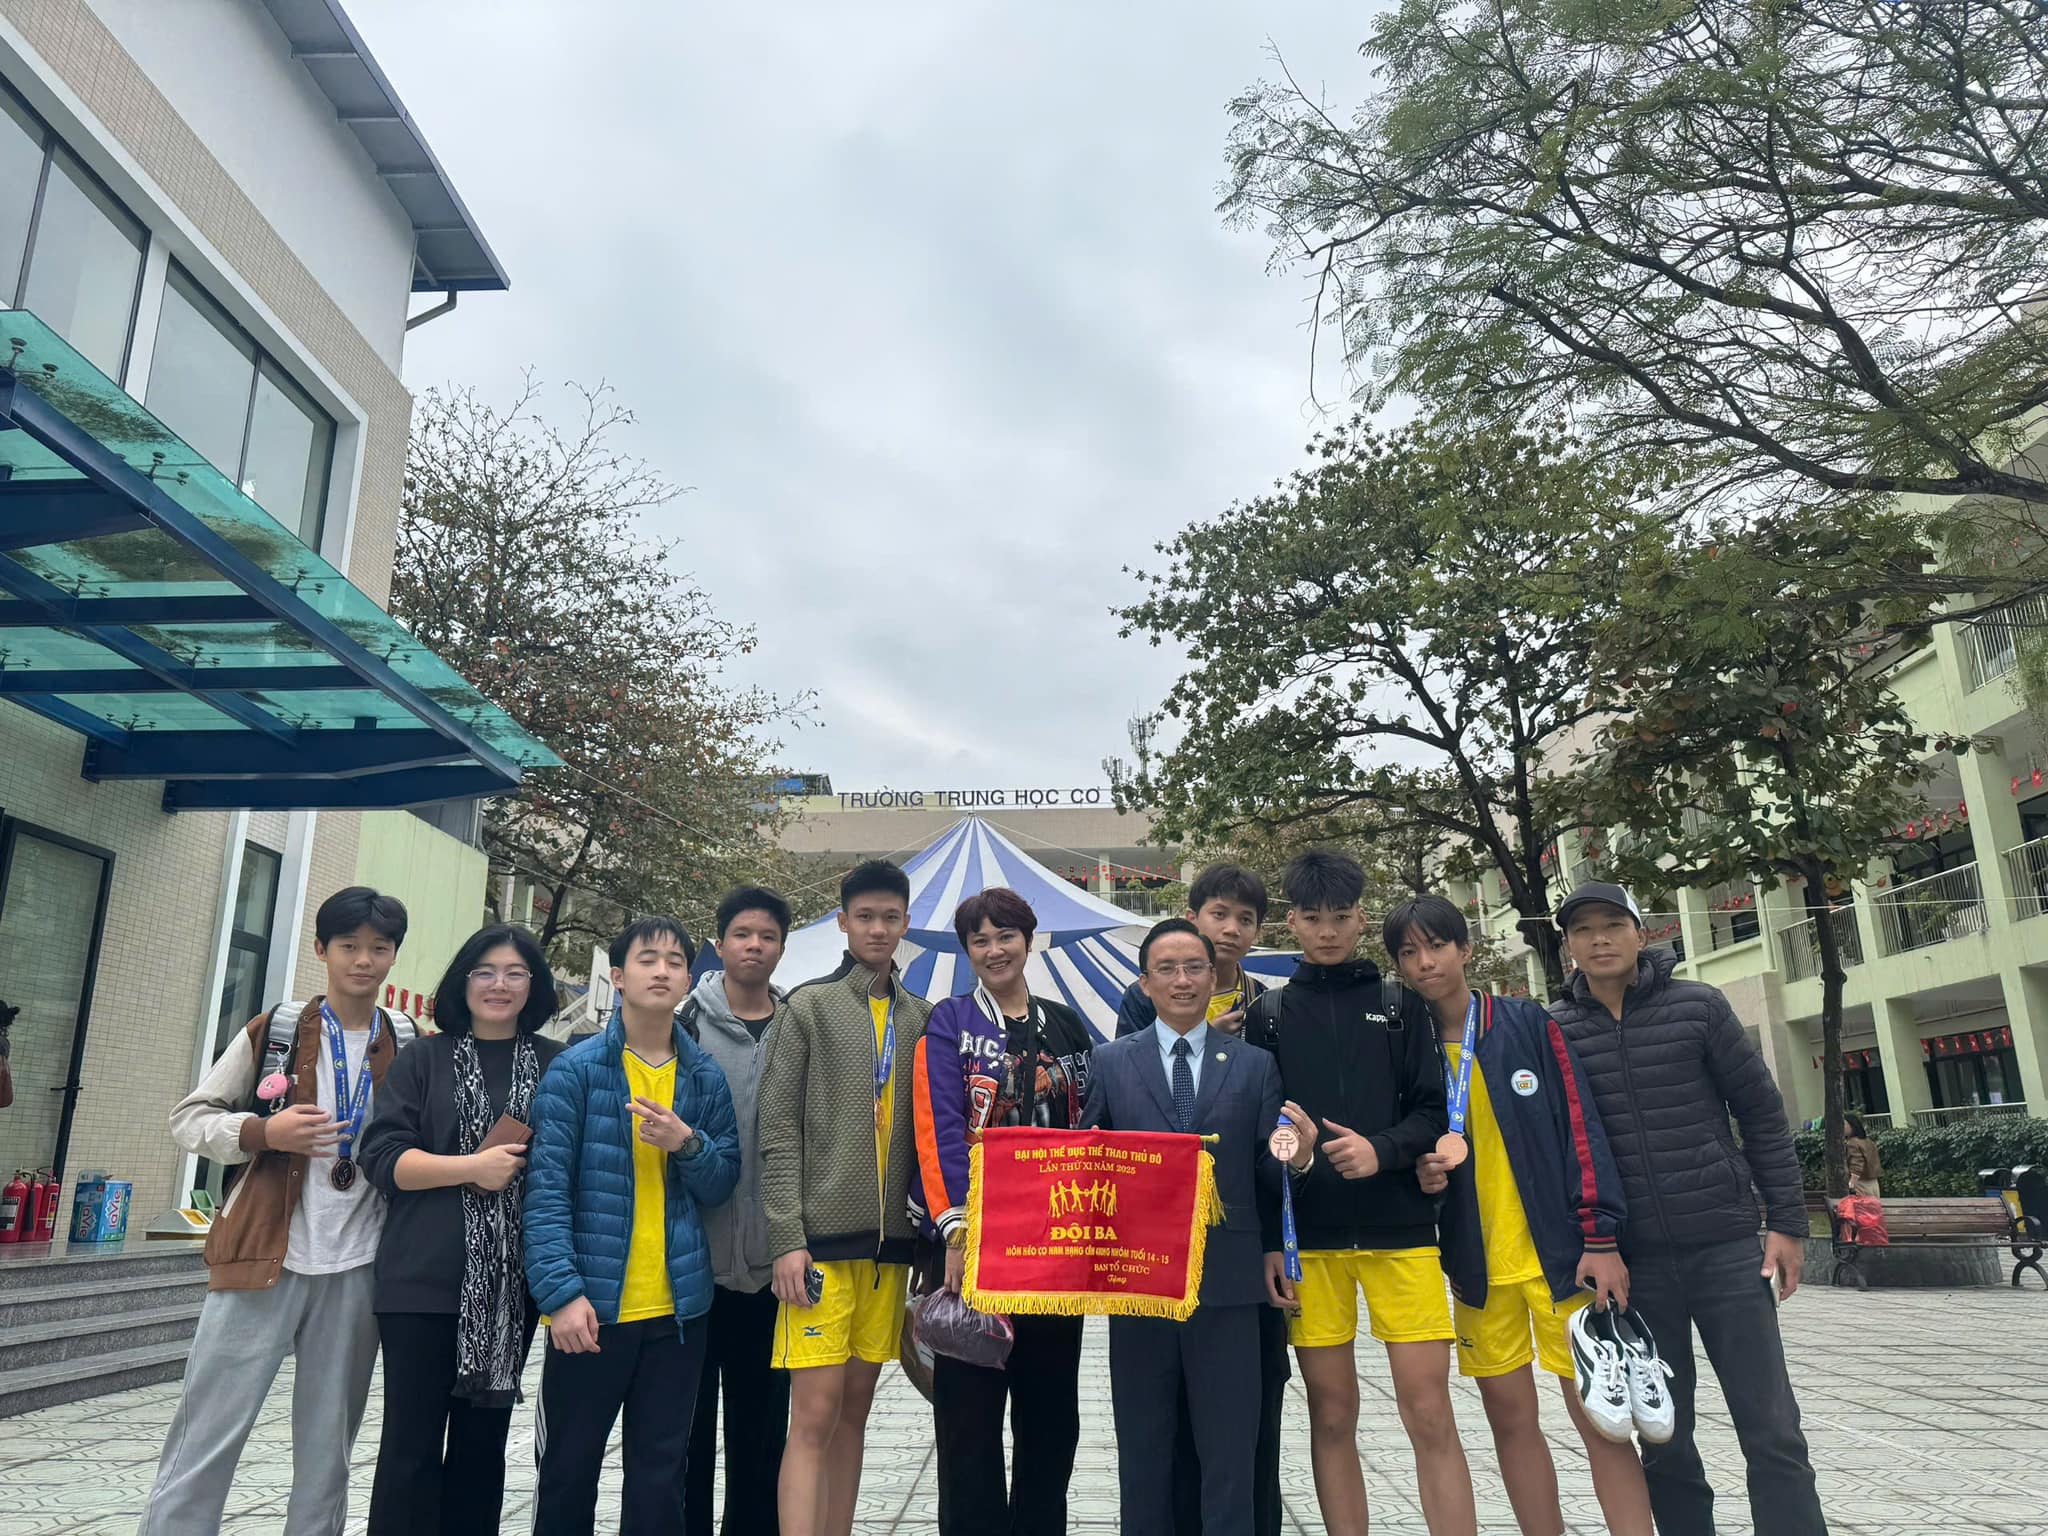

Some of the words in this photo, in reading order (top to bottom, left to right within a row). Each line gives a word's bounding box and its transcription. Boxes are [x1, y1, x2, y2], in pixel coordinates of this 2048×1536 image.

[837, 785, 924, 808] TRƯỜNG
[934, 790, 1005, 806] TRUNG
[1015, 789, 1059, 808] HỌC
[1070, 786, 1100, 804] CƠ
[1365, 1012, 1387, 1022] Kapp
[1032, 1147, 1047, 1160] HỘI
[1067, 1146, 1086, 1158] DỤC
[1105, 1147, 1128, 1160] THAO
[1083, 1162, 1092, 1170] XI
[1116, 1164, 1136, 1174] 2025
[1050, 1222, 1090, 1243] ĐỘI
[1094, 1226, 1117, 1240] BA
[1147, 1252, 1155, 1261] 14
[1162, 1255, 1169, 1264] 15
[1094, 1263, 1108, 1271] BAN
[1121, 1264, 1150, 1275] CHỨC
